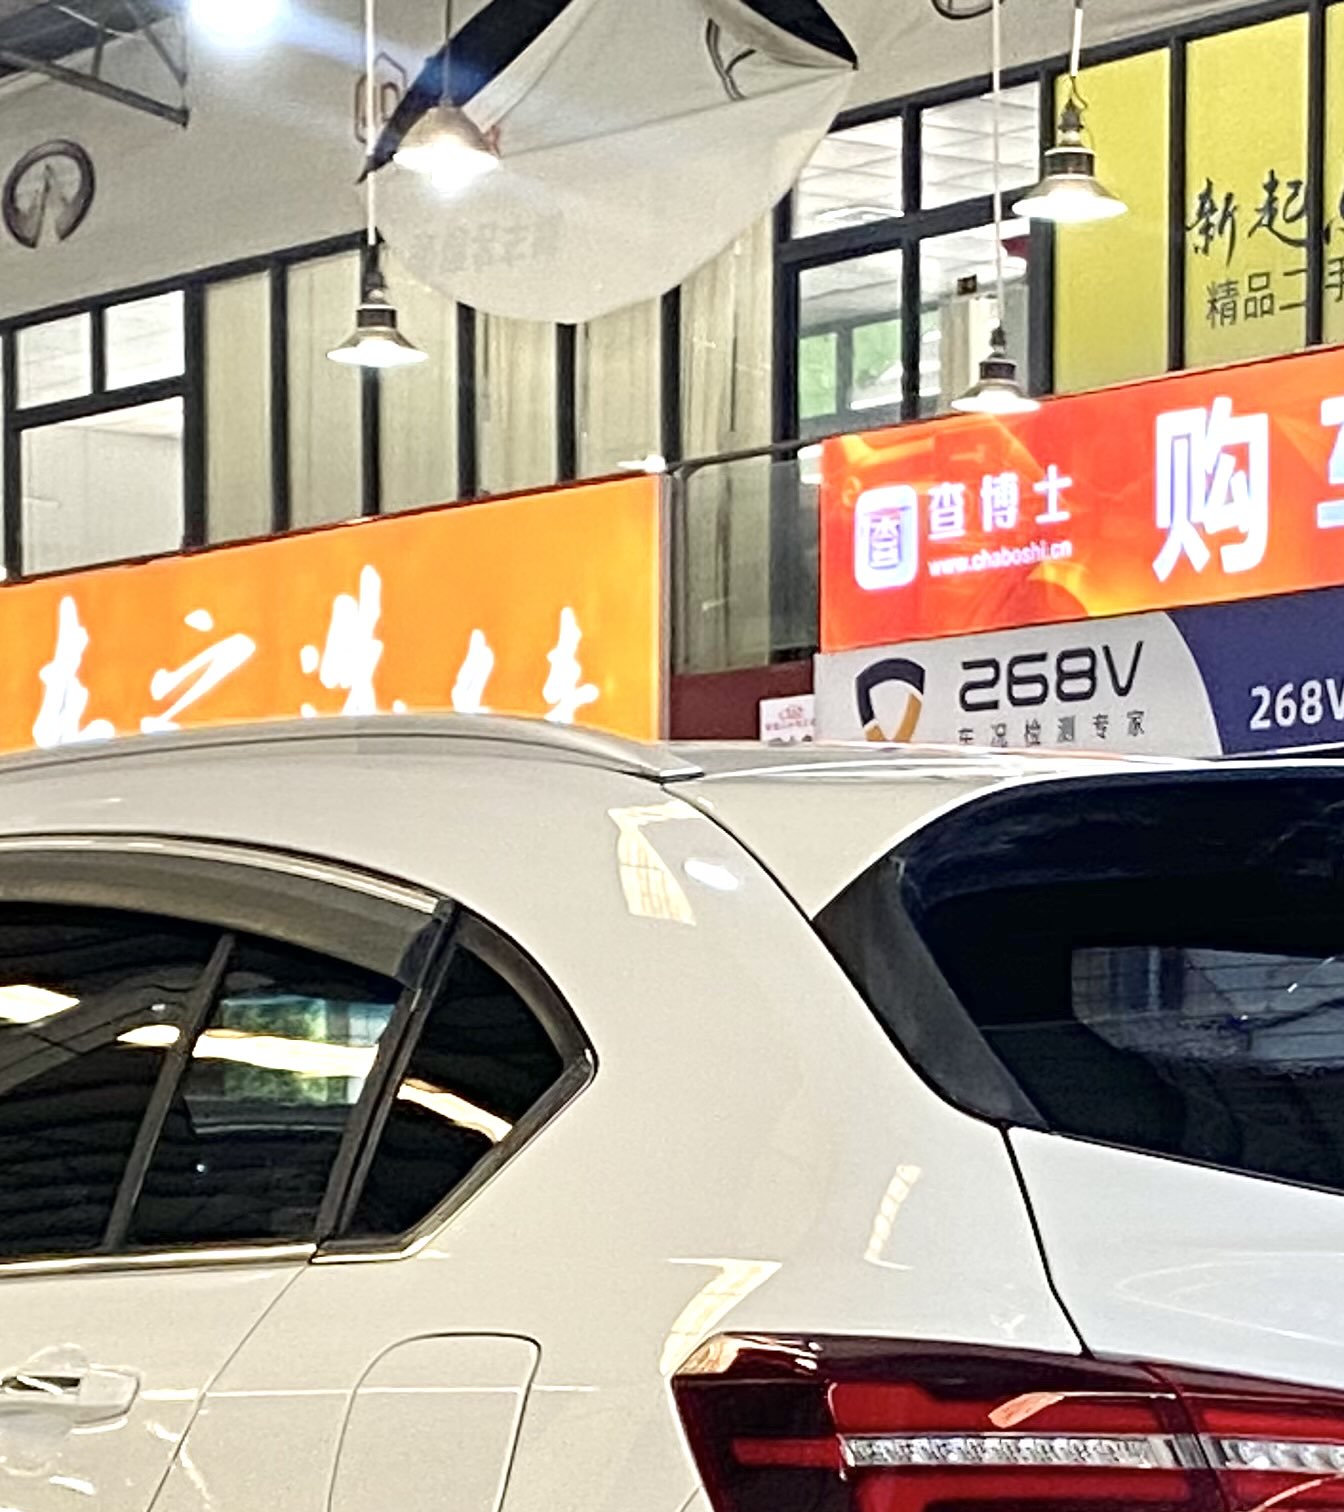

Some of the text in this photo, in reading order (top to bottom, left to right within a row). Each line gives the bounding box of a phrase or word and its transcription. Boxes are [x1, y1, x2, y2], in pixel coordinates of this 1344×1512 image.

[927, 463, 1073, 541] 查博士
[959, 640, 1144, 712] 268V
